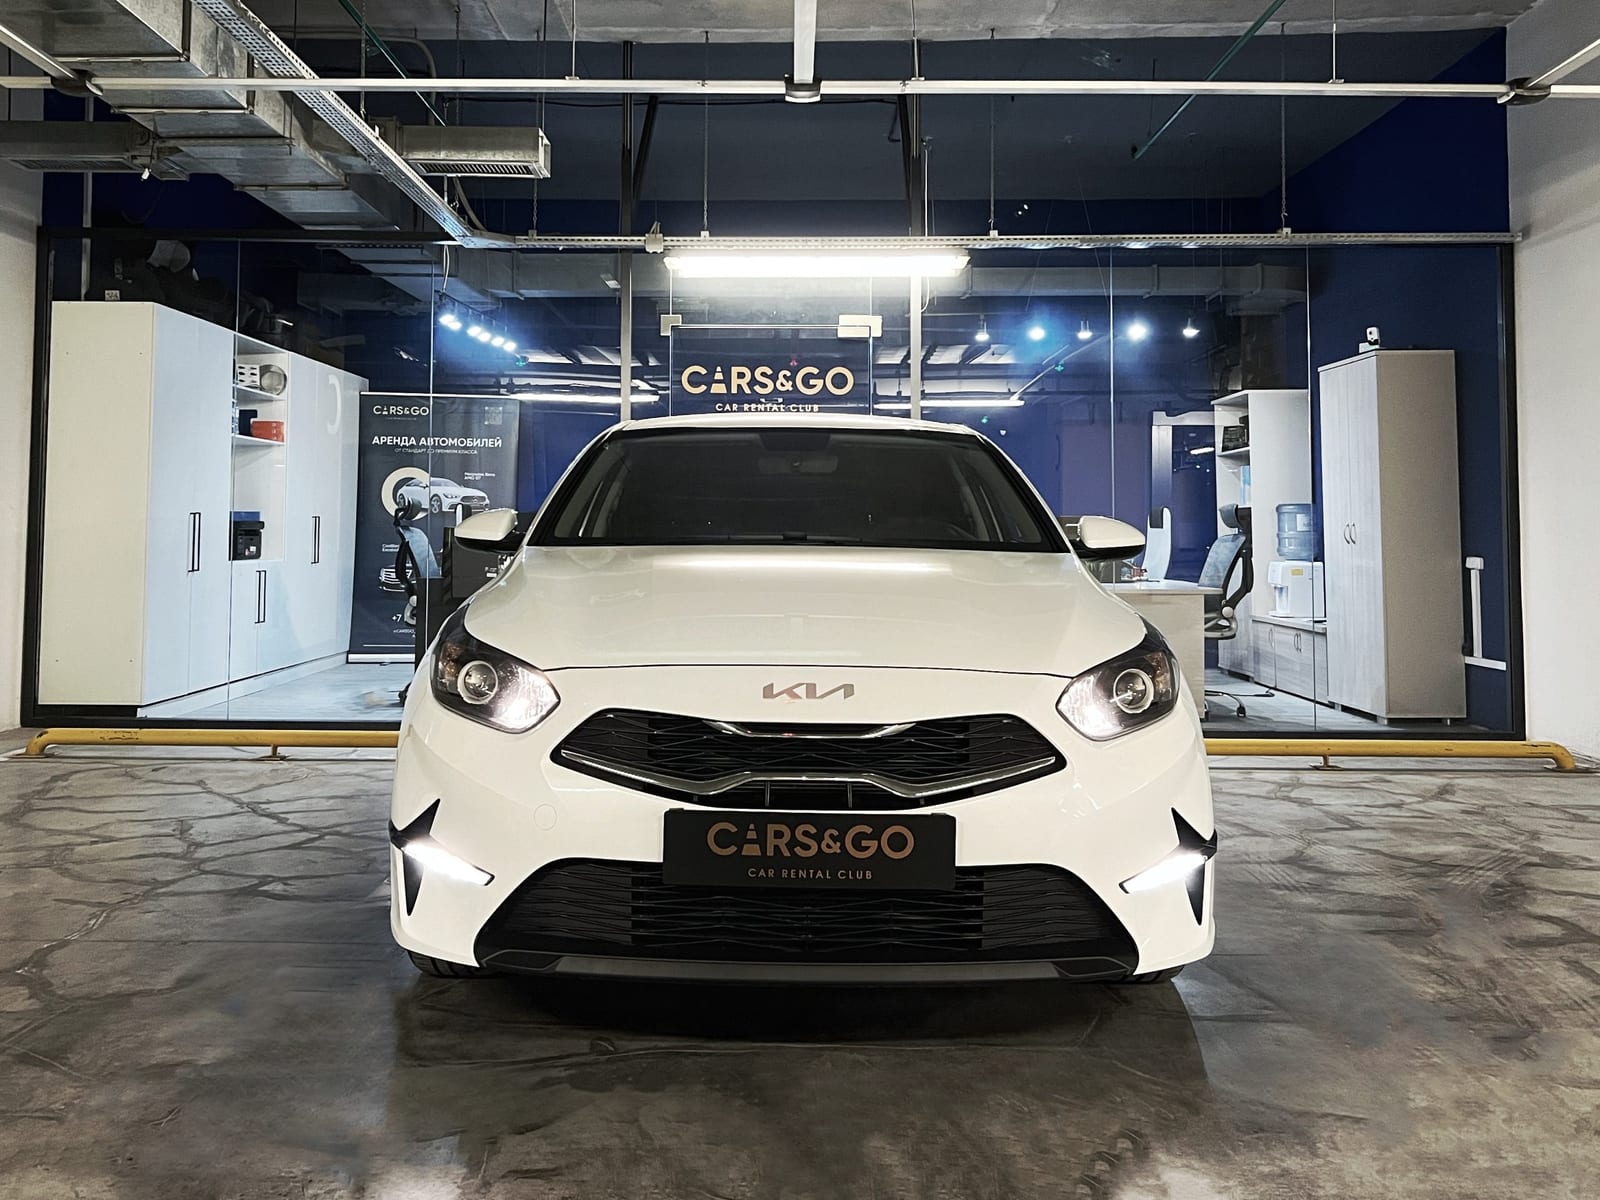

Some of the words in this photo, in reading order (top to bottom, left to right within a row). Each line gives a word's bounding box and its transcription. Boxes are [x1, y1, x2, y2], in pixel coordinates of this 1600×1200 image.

[715, 403, 738, 412] CAR
[743, 403, 786, 412] RENTAL
[790, 403, 819, 412] CLUB
[372, 436, 417, 447] АРЕНДА
[419, 436, 502, 448] АВТОМОБИЛЕЙ
[747, 868, 775, 879] CAR
[782, 868, 831, 880] RENTAL
[837, 868, 873, 880] CLUB
